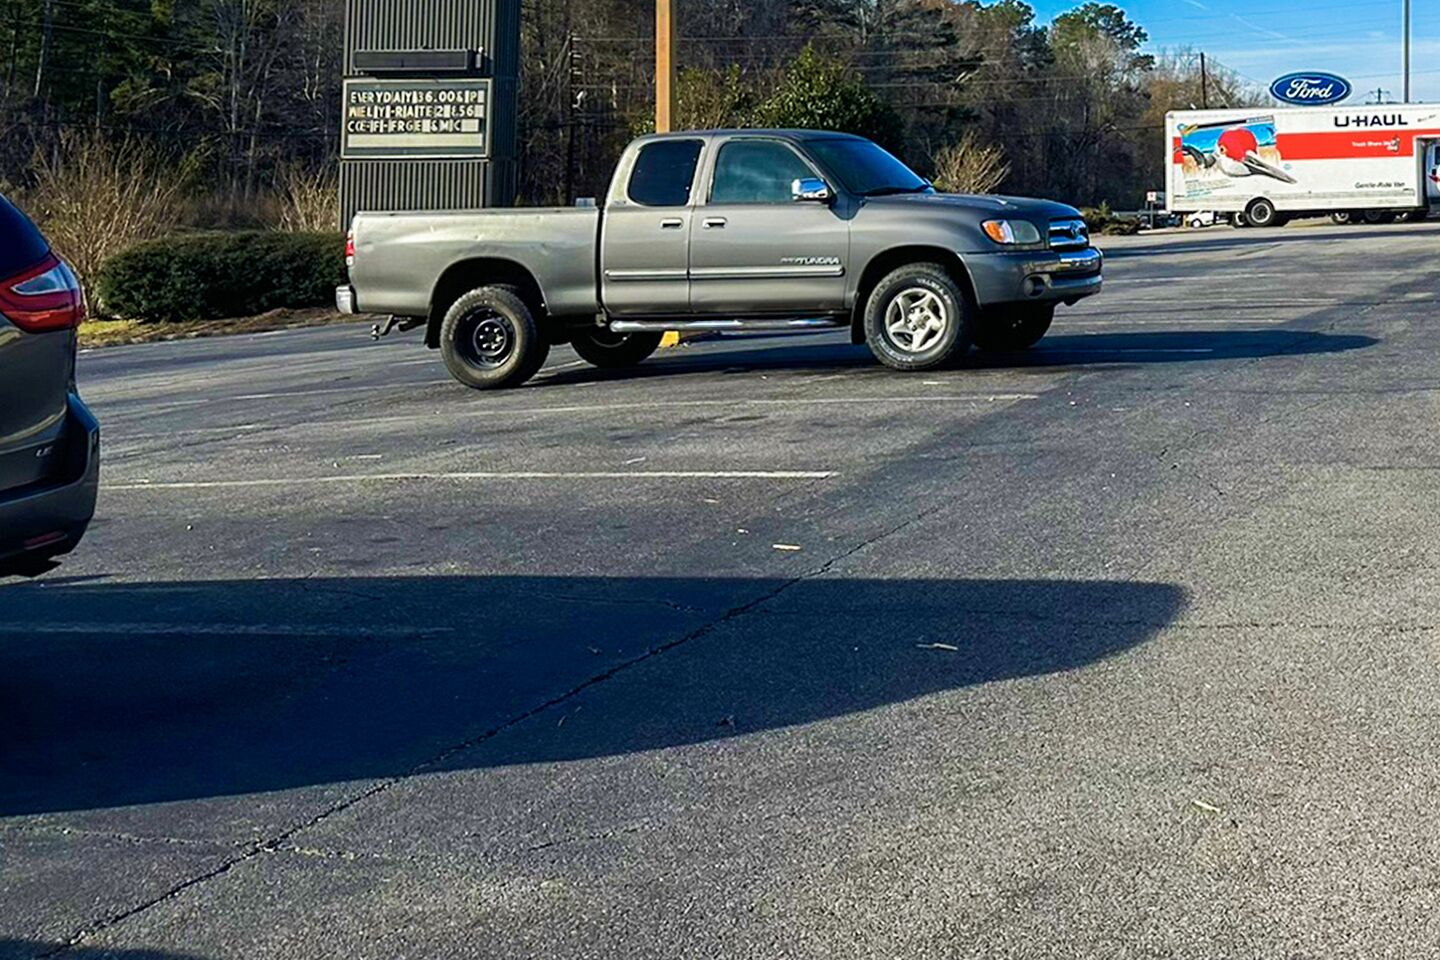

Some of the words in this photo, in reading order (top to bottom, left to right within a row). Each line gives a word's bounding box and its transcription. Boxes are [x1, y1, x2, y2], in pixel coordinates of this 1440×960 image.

[1285, 78, 1334, 98] Ford
[1334, 113, 1408, 127] U-HAUL
[798, 256, 840, 265] TUNDRA
